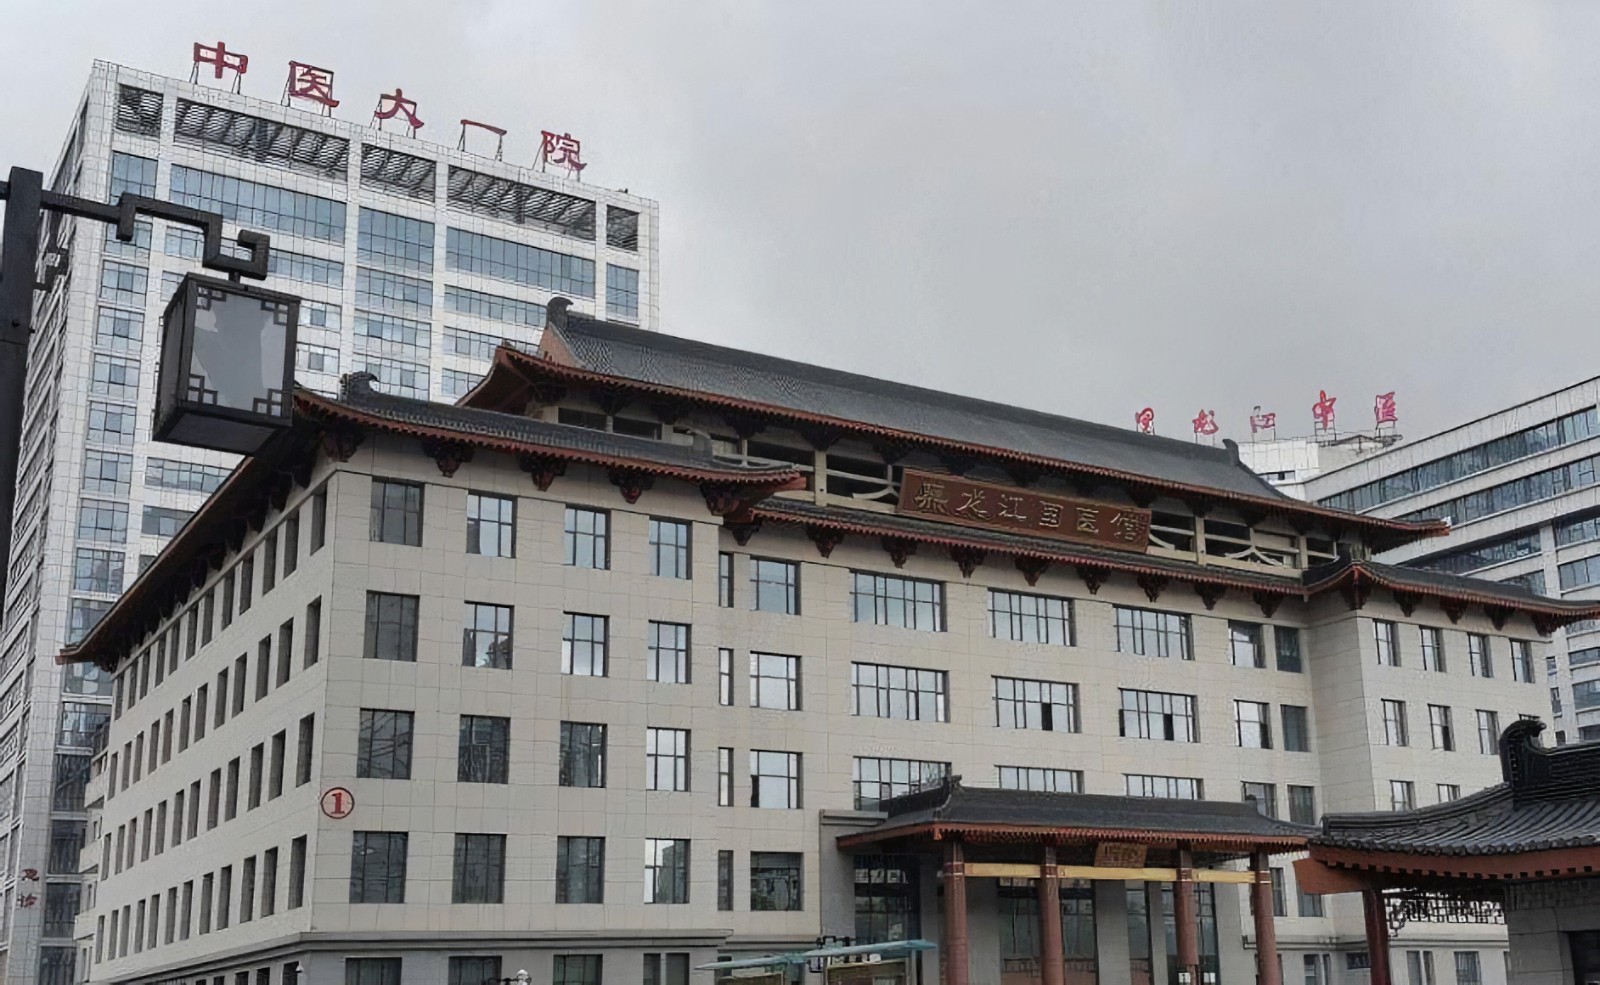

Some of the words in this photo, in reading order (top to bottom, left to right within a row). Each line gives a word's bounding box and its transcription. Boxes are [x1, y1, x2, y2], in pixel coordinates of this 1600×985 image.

[193, 41, 588, 171] 中医大一院
